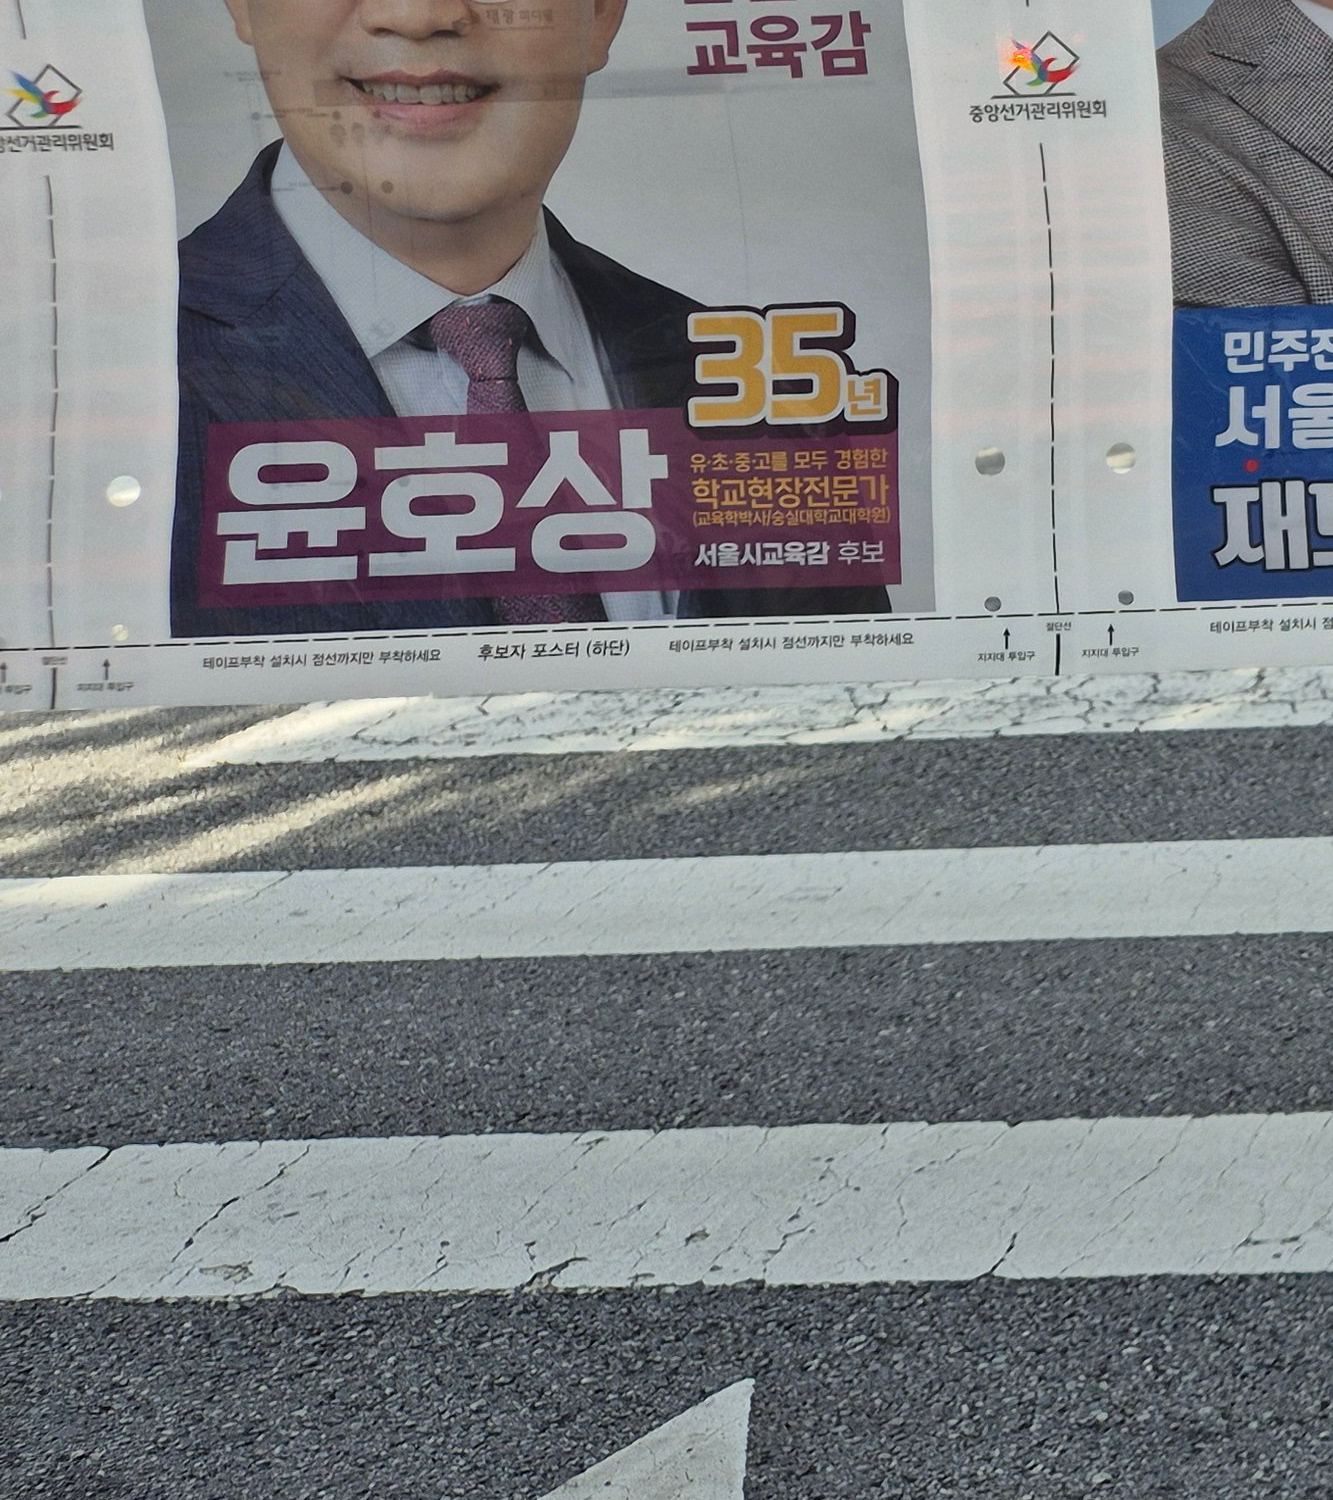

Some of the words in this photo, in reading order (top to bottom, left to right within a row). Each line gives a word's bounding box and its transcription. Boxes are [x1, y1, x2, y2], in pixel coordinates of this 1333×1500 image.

[686, 11, 871, 78] 교육감
[969, 100, 1107, 123] 중앙선거관리위원회
[688, 307, 890, 427] 35년
[794, 450, 828, 470] 모두
[836, 447, 888, 469] 경험한
[692, 474, 889, 510] 학교현장전문가
[216, 427, 669, 585] 윤호상
[692, 508, 891, 527] (교육학박사/숭실대학교대학원)
[694, 541, 829, 567] 서울시교육감
[837, 541, 886, 565] 후보
[478, 644, 525, 661] 후보자
[532, 642, 579, 657] 포스터
[587, 640, 629, 657] (하단)
